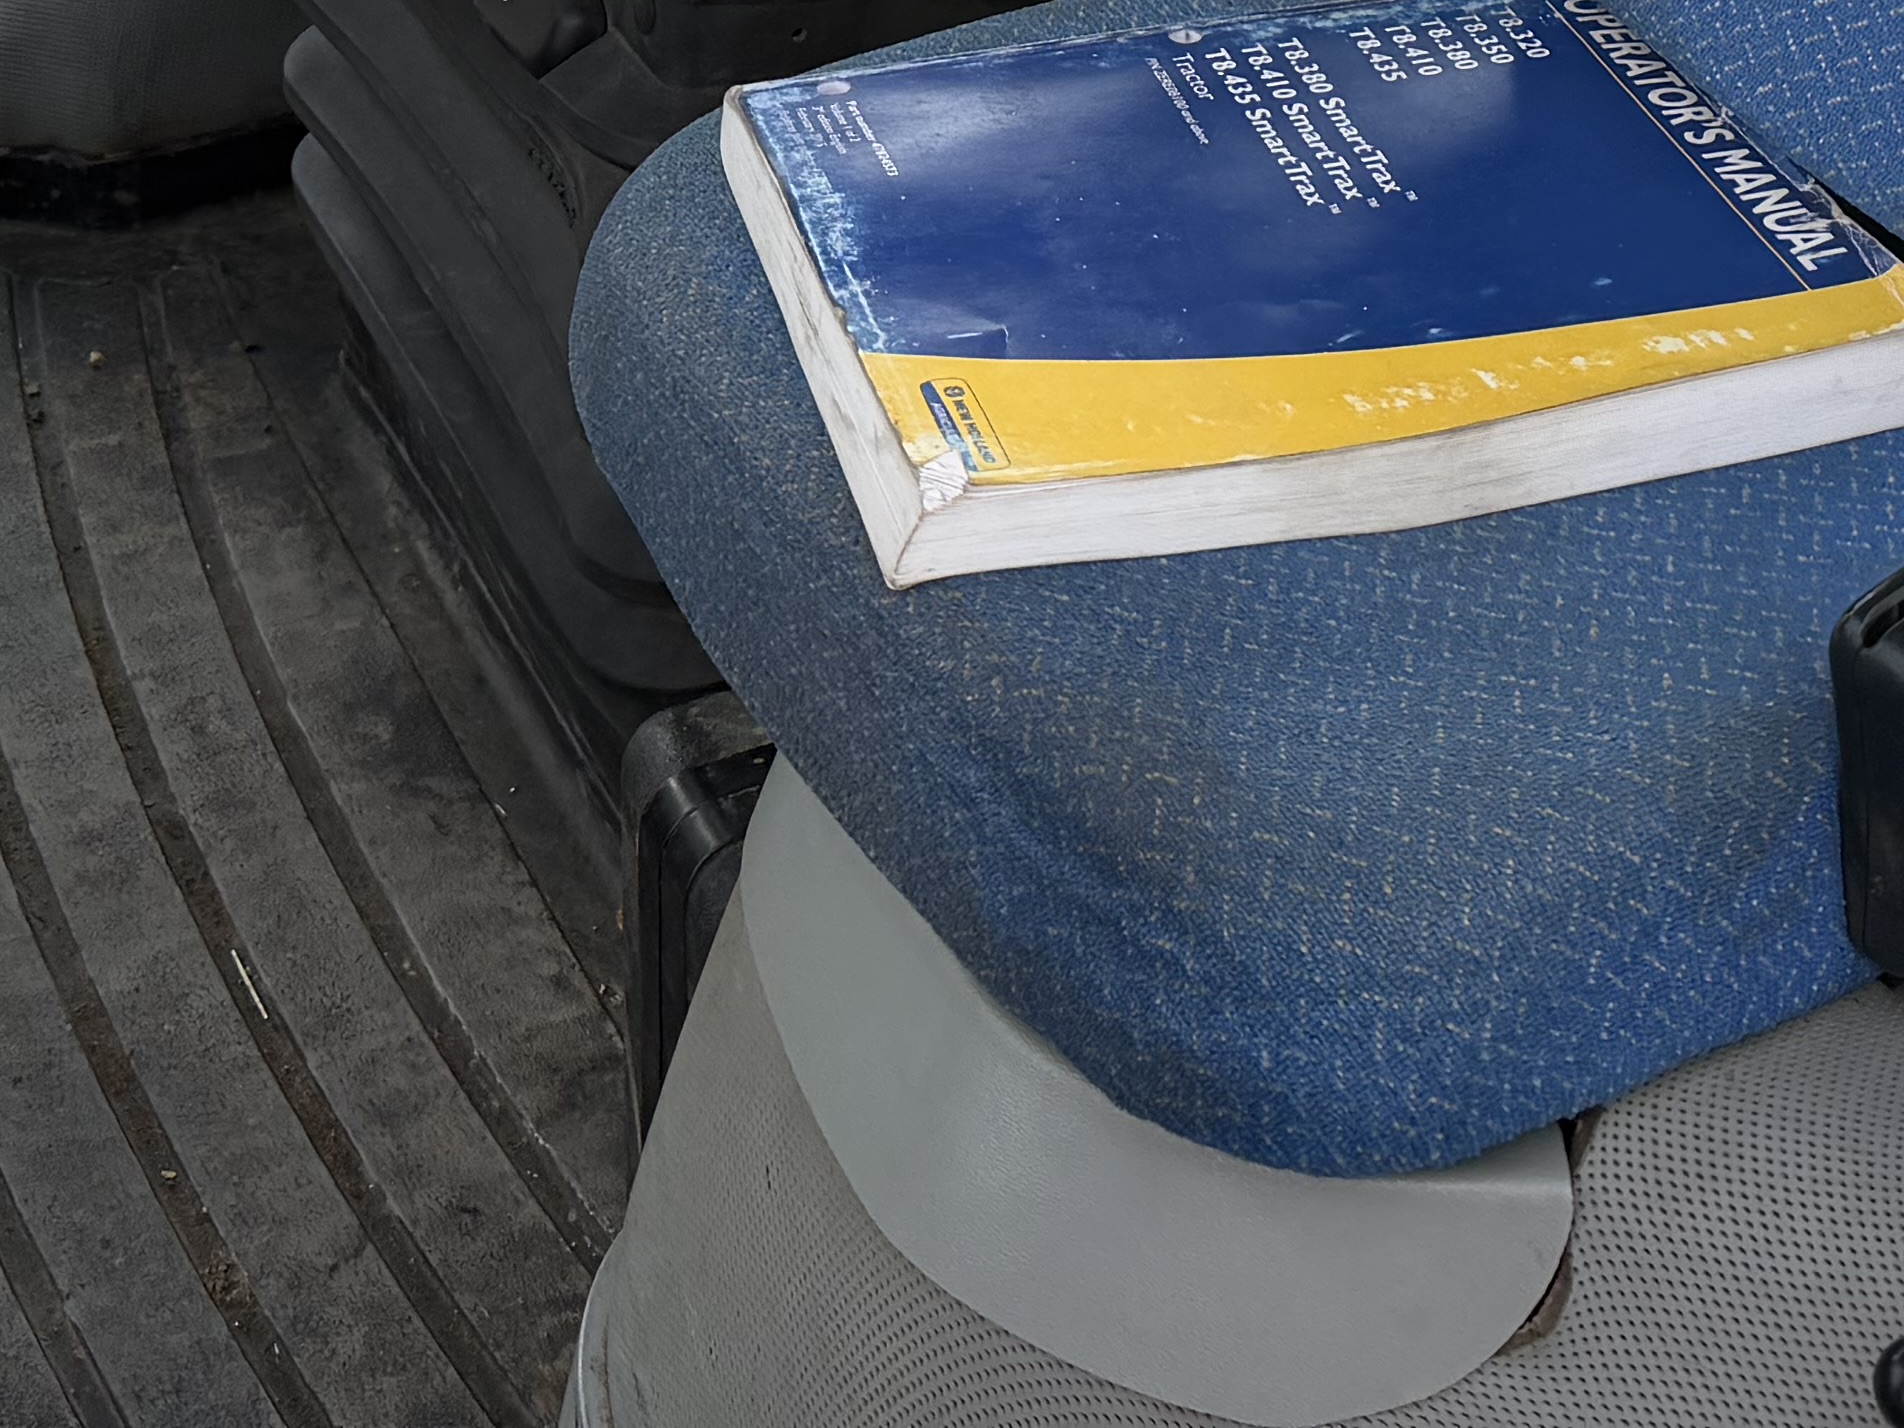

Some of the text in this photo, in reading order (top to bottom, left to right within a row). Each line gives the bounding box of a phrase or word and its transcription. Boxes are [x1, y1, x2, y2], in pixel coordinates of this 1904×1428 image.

[1349, 27, 1407, 82] T8.435
[1385, 25, 1443, 76] T8.410
[1420, 16, 1479, 70] T8.380
[1455, 13, 1515, 64] T8.350
[1491, 4, 1550, 59] T8.320
[1172, 52, 1215, 101] Tractor
[1205, 47, 1262, 105] T8.435
[1241, 42, 1297, 100] T8.410
[1278, 37, 1333, 94] T8.380
[1702, 147, 1848, 272] MANUAL
[952, 399, 996, 463] NEW HOLLAND
